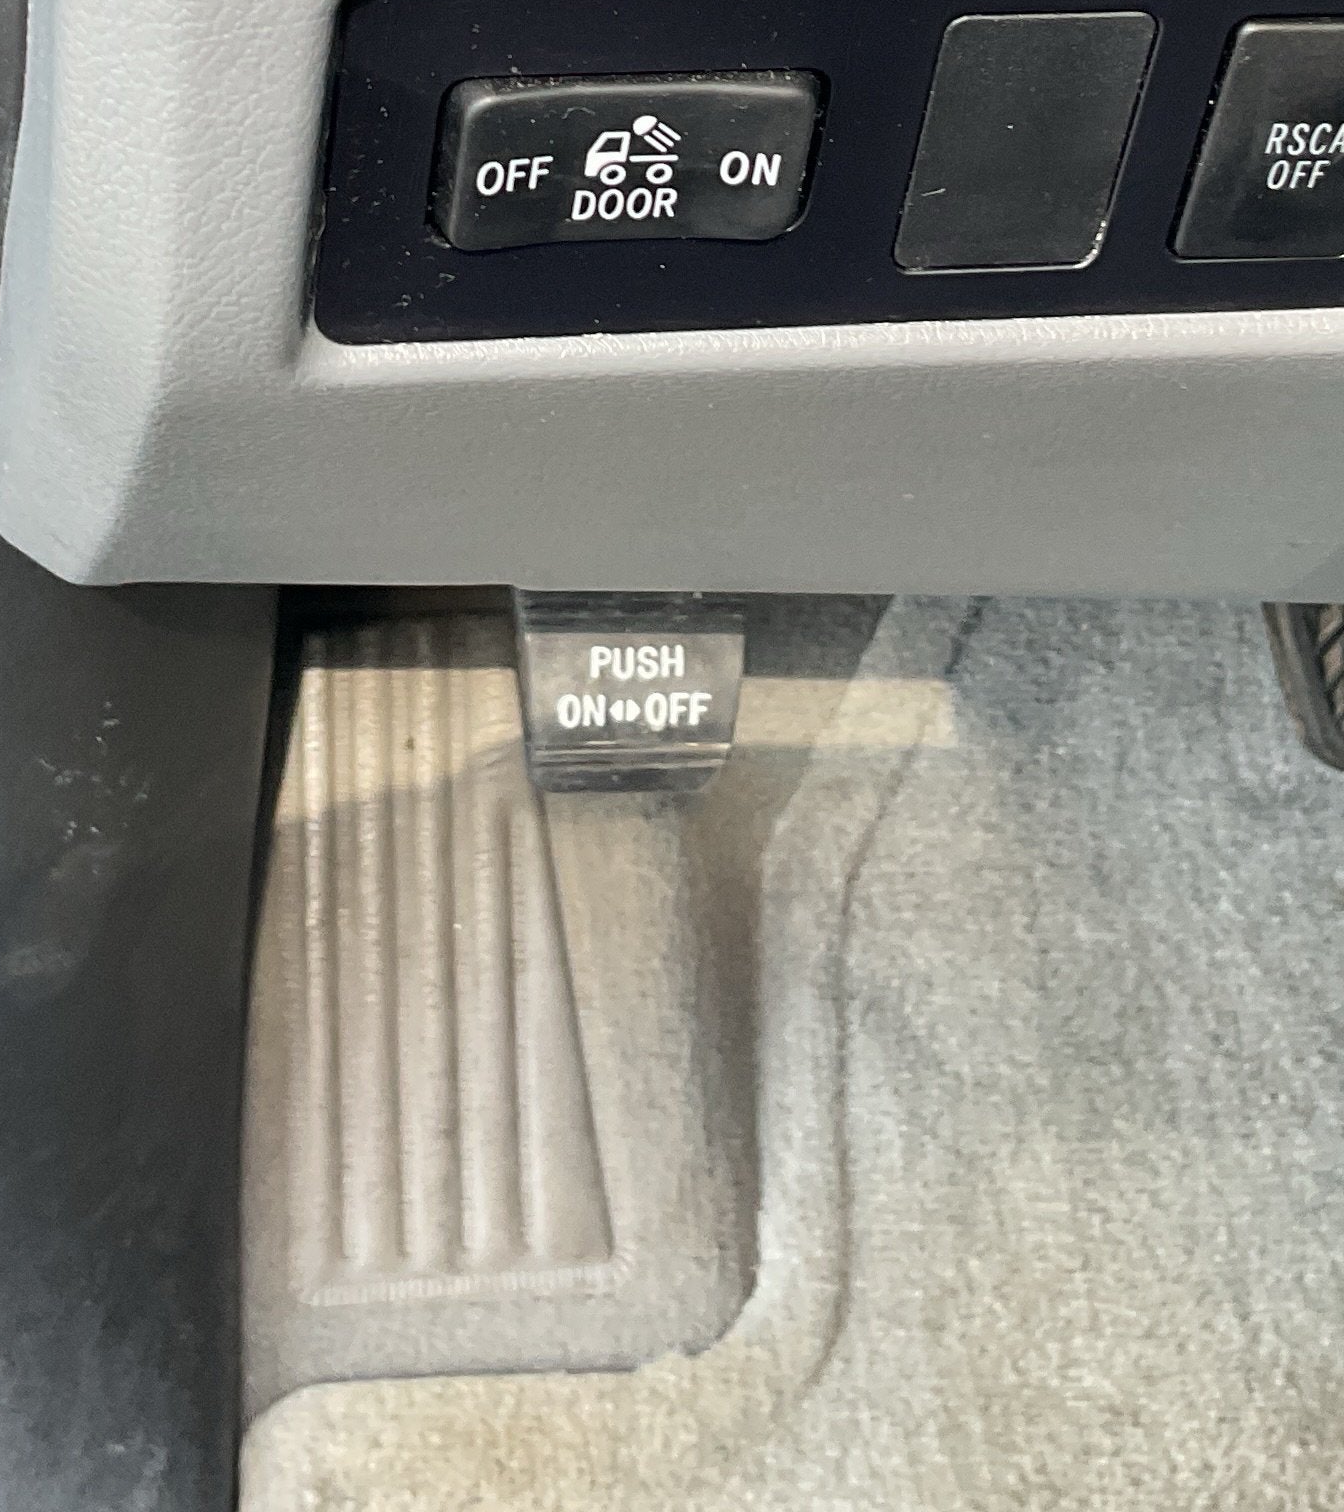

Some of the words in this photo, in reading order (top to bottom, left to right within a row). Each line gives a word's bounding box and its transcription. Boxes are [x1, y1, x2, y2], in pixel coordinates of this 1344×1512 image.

[476, 155, 554, 196] OFF
[719, 150, 782, 187] ON
[1266, 159, 1332, 191] OFF
[570, 187, 678, 221] DOOR
[588, 644, 686, 680] PUSH
[556, 692, 608, 729] ON
[643, 691, 713, 731] OFF
